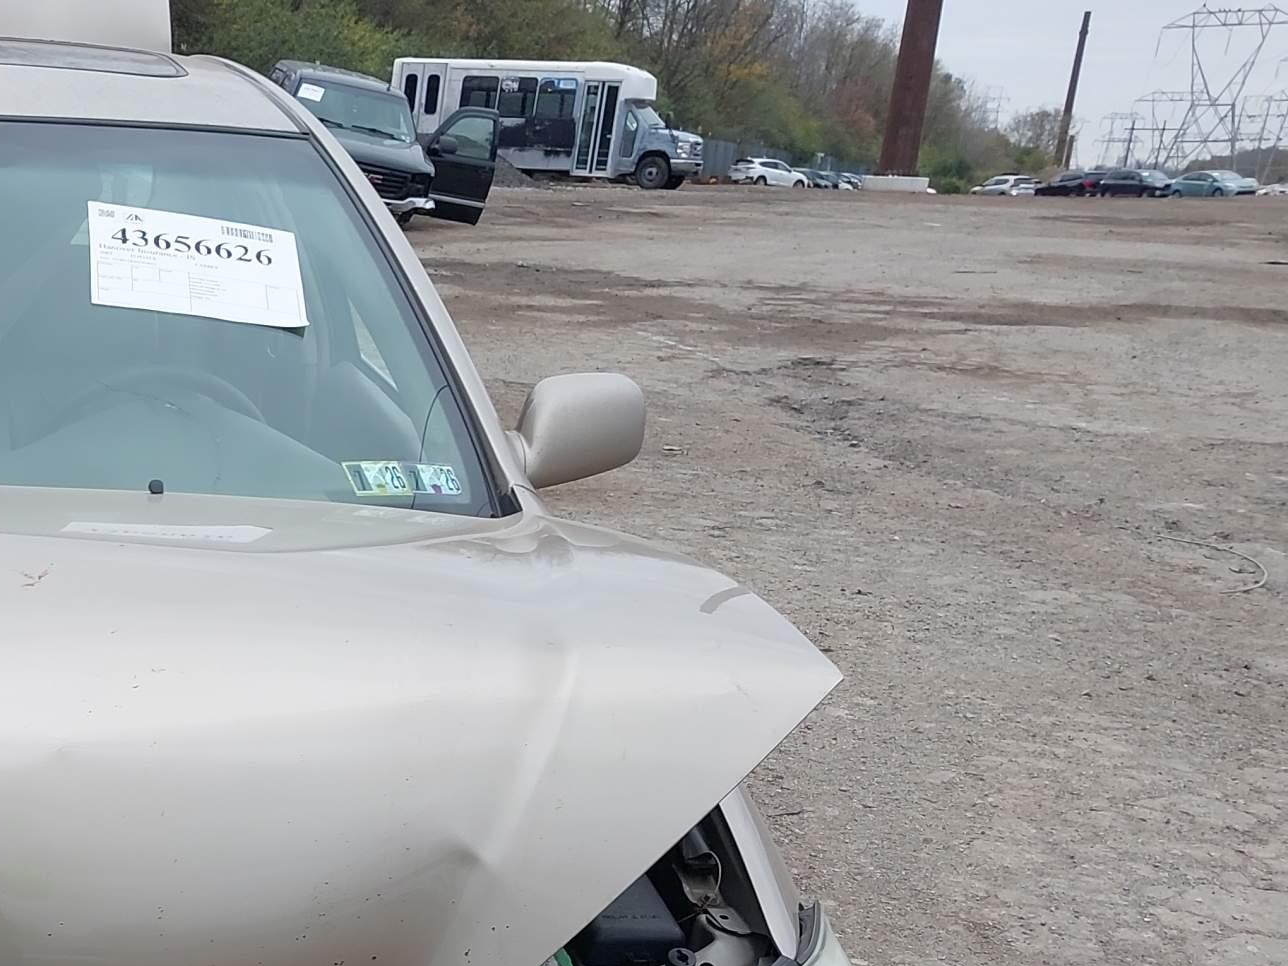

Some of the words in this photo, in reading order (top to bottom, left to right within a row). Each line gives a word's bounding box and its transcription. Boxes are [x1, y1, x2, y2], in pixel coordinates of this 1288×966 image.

[112, 227, 273, 266] 43656626
[385, 466, 406, 490] 26
[440, 468, 460, 492] 26
